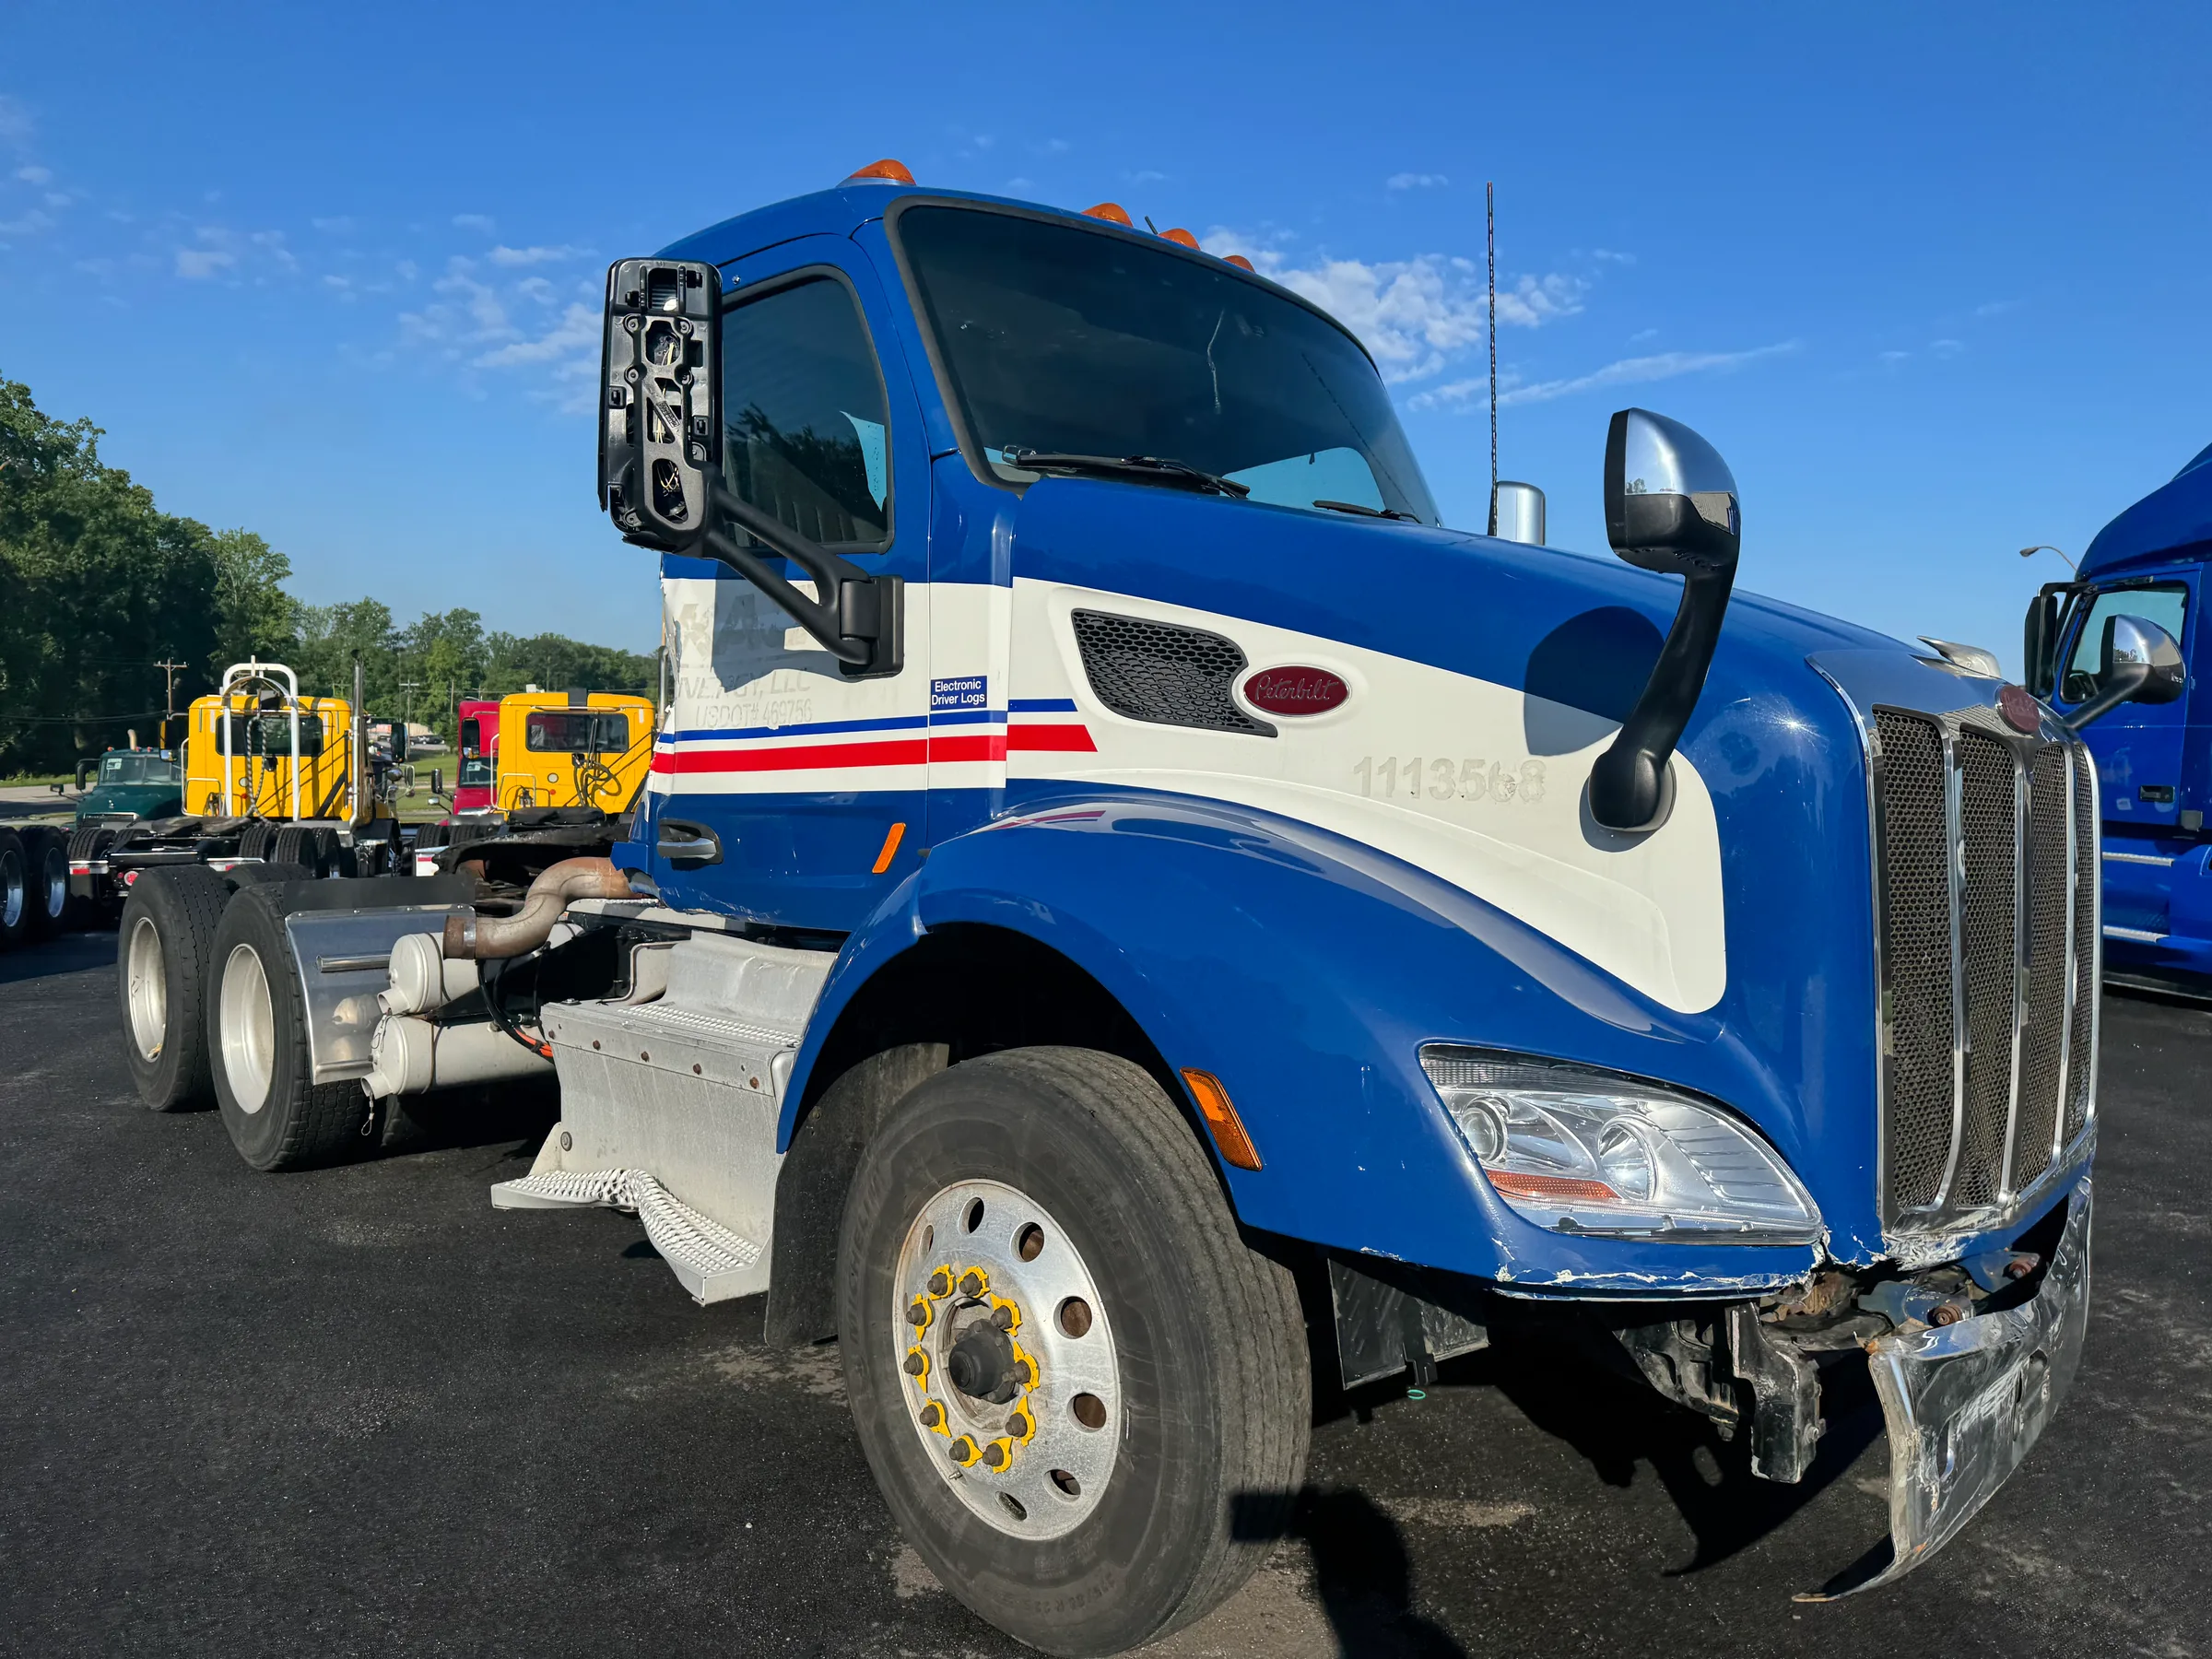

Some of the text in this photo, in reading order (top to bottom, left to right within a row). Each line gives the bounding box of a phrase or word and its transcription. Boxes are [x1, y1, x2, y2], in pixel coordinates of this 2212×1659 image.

[935, 678, 982, 692] Electronic
[1255, 675, 1338, 700] Peterbilt
[931, 692, 985, 706] Driver Logs
[696, 698, 813, 728] USDOT# 469756
[1353, 756, 1547, 803] 1113568
